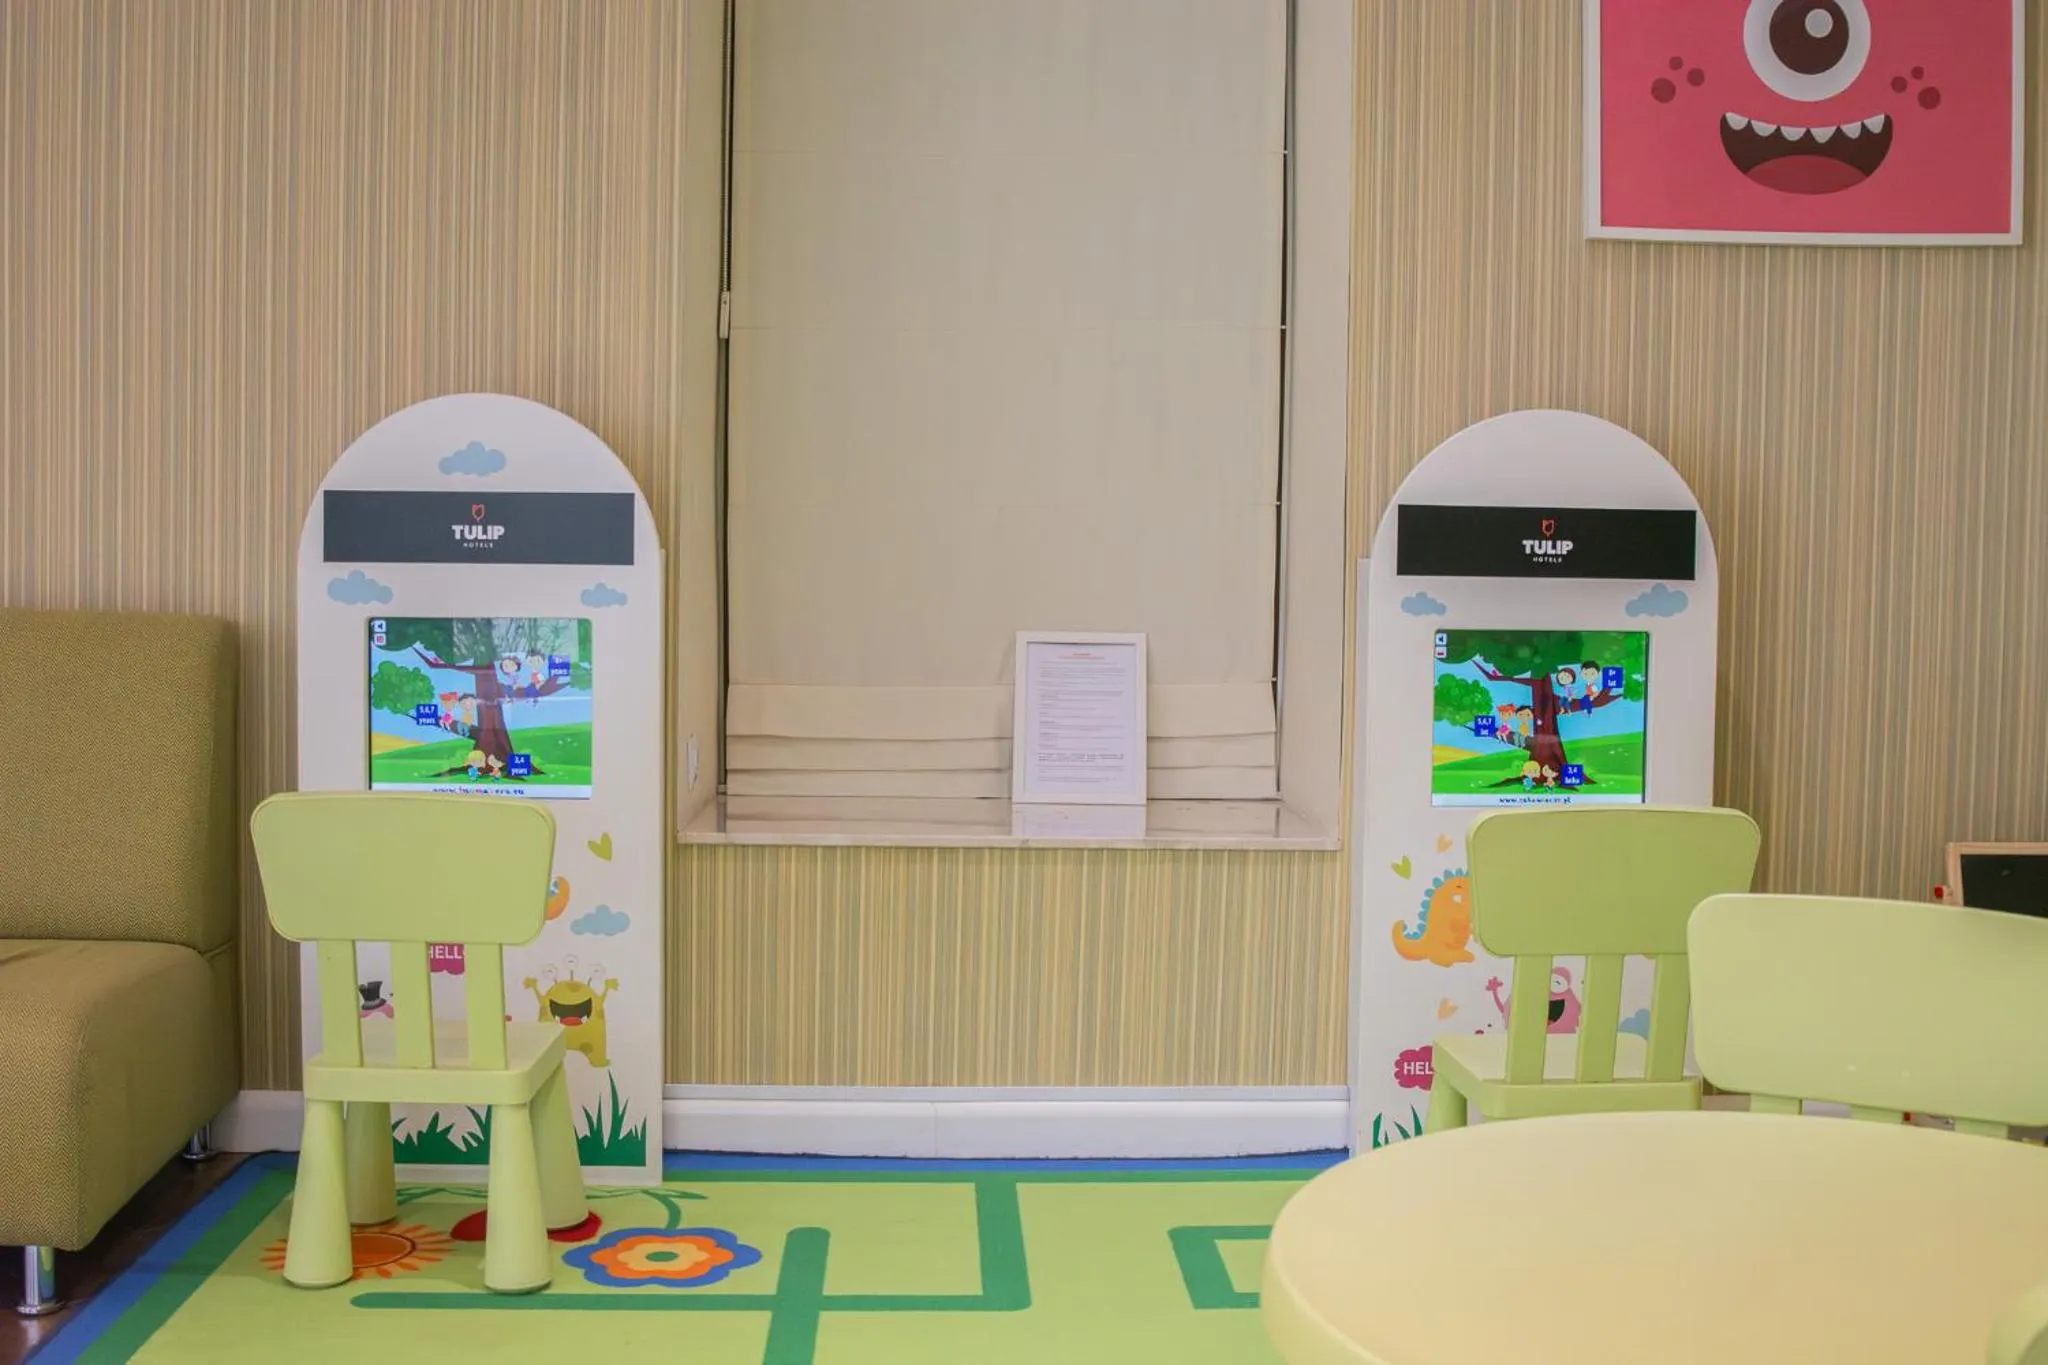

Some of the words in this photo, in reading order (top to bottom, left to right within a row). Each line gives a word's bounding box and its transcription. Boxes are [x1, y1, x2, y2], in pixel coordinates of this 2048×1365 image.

[451, 525, 505, 540] TULIP
[1522, 539, 1574, 555] TULIP
[419, 717, 435, 725] years
[514, 756, 525, 764] 3,4
[511, 768, 528, 776] years
[430, 944, 463, 959] ELL
[1403, 1061, 1433, 1075] HEL
